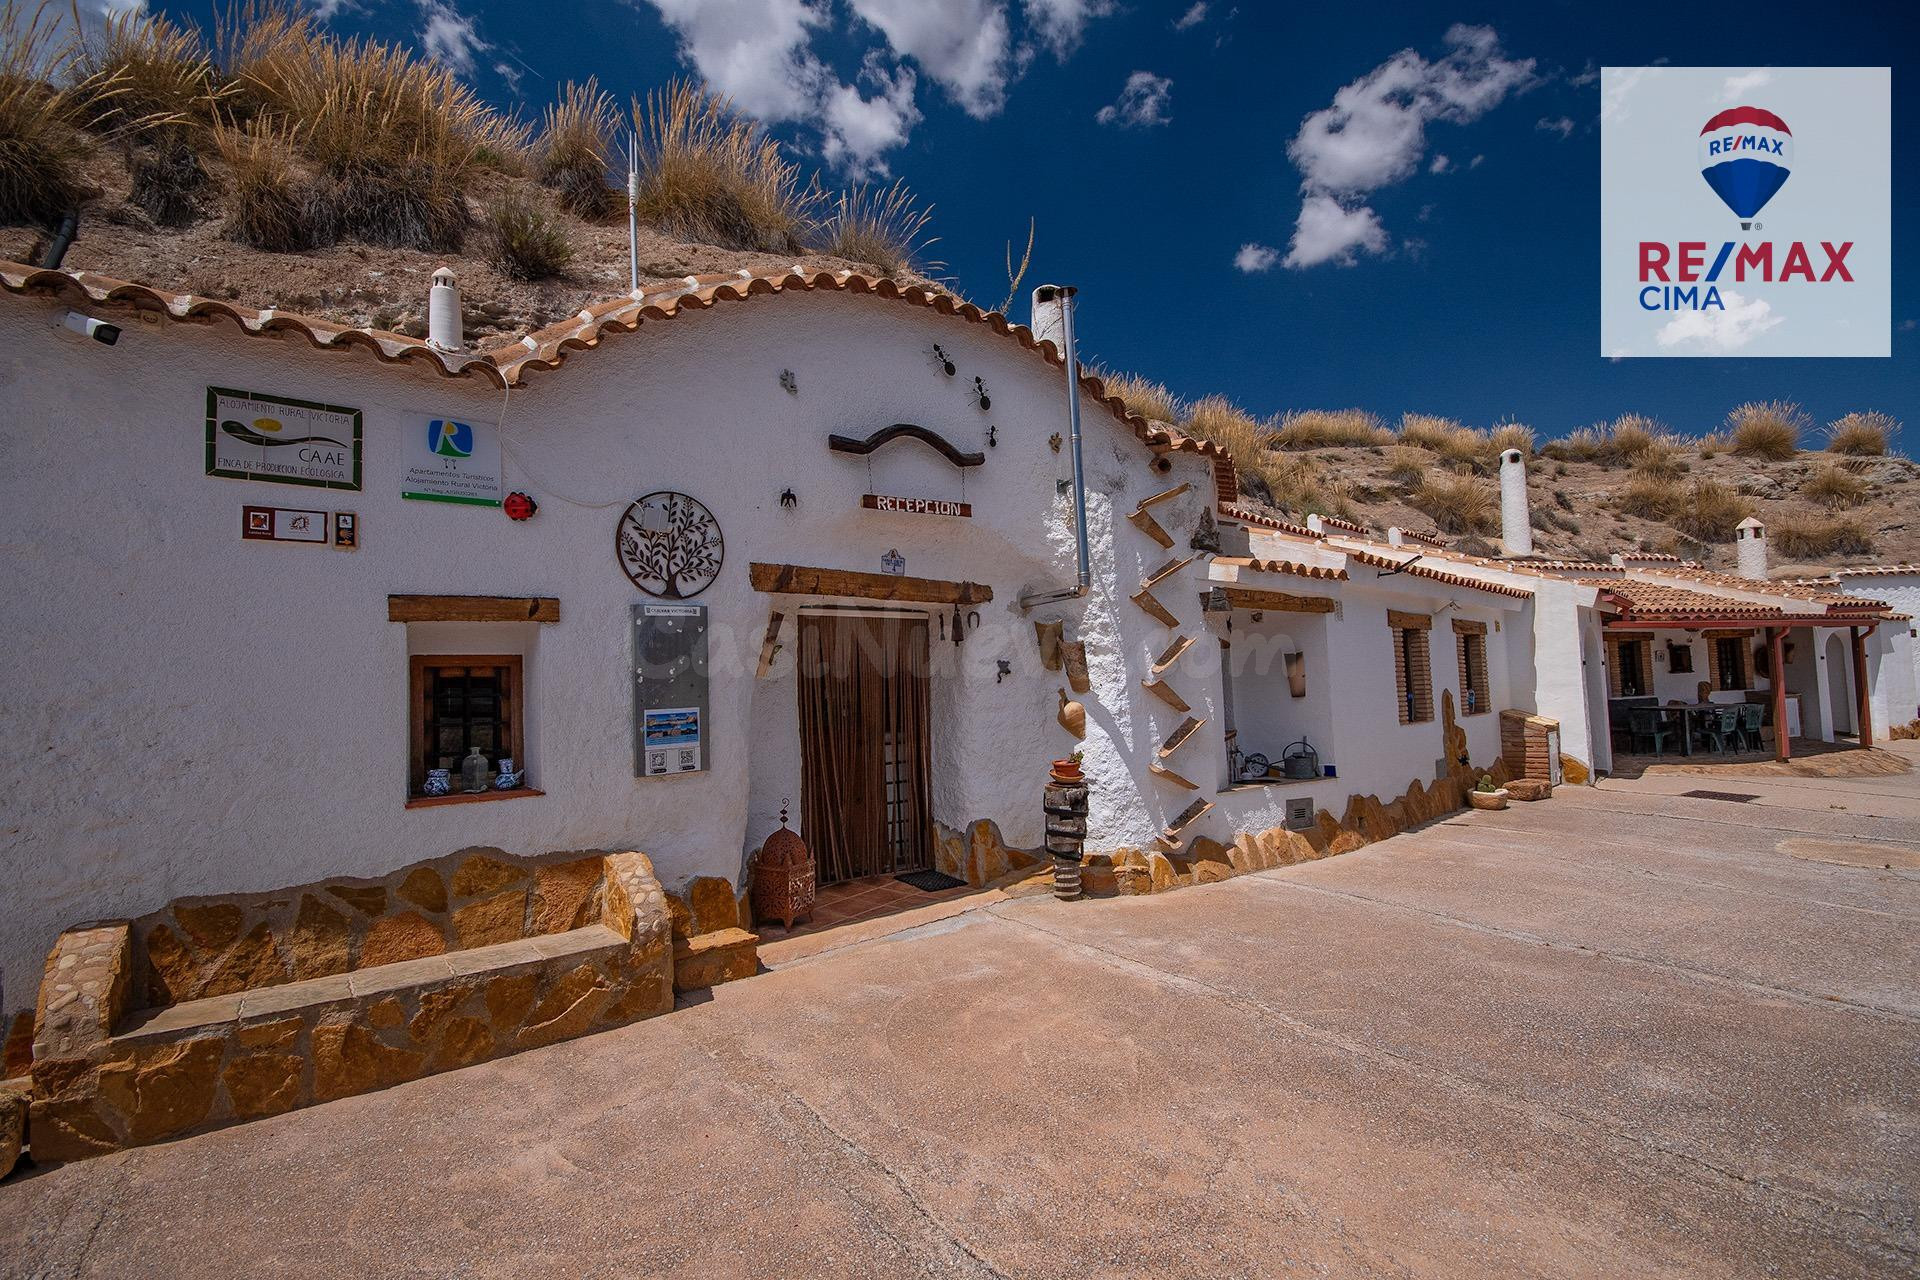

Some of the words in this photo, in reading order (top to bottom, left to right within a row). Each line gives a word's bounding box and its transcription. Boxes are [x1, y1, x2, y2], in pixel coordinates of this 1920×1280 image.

[218, 398, 275, 414] ALOJAMIENTO
[279, 406, 305, 419] RURAL
[310, 411, 350, 425] VICTORIA
[217, 457, 242, 469] FINCA
[243, 460, 253, 470] DE
[298, 448, 345, 466] CAAE
[409, 467, 460, 478] Apartamentos
[405, 476, 449, 486] Alojamiento
[450, 480, 471, 488] Rural
[472, 482, 498, 491] Victoria
[876, 496, 961, 517] RECEPCION
